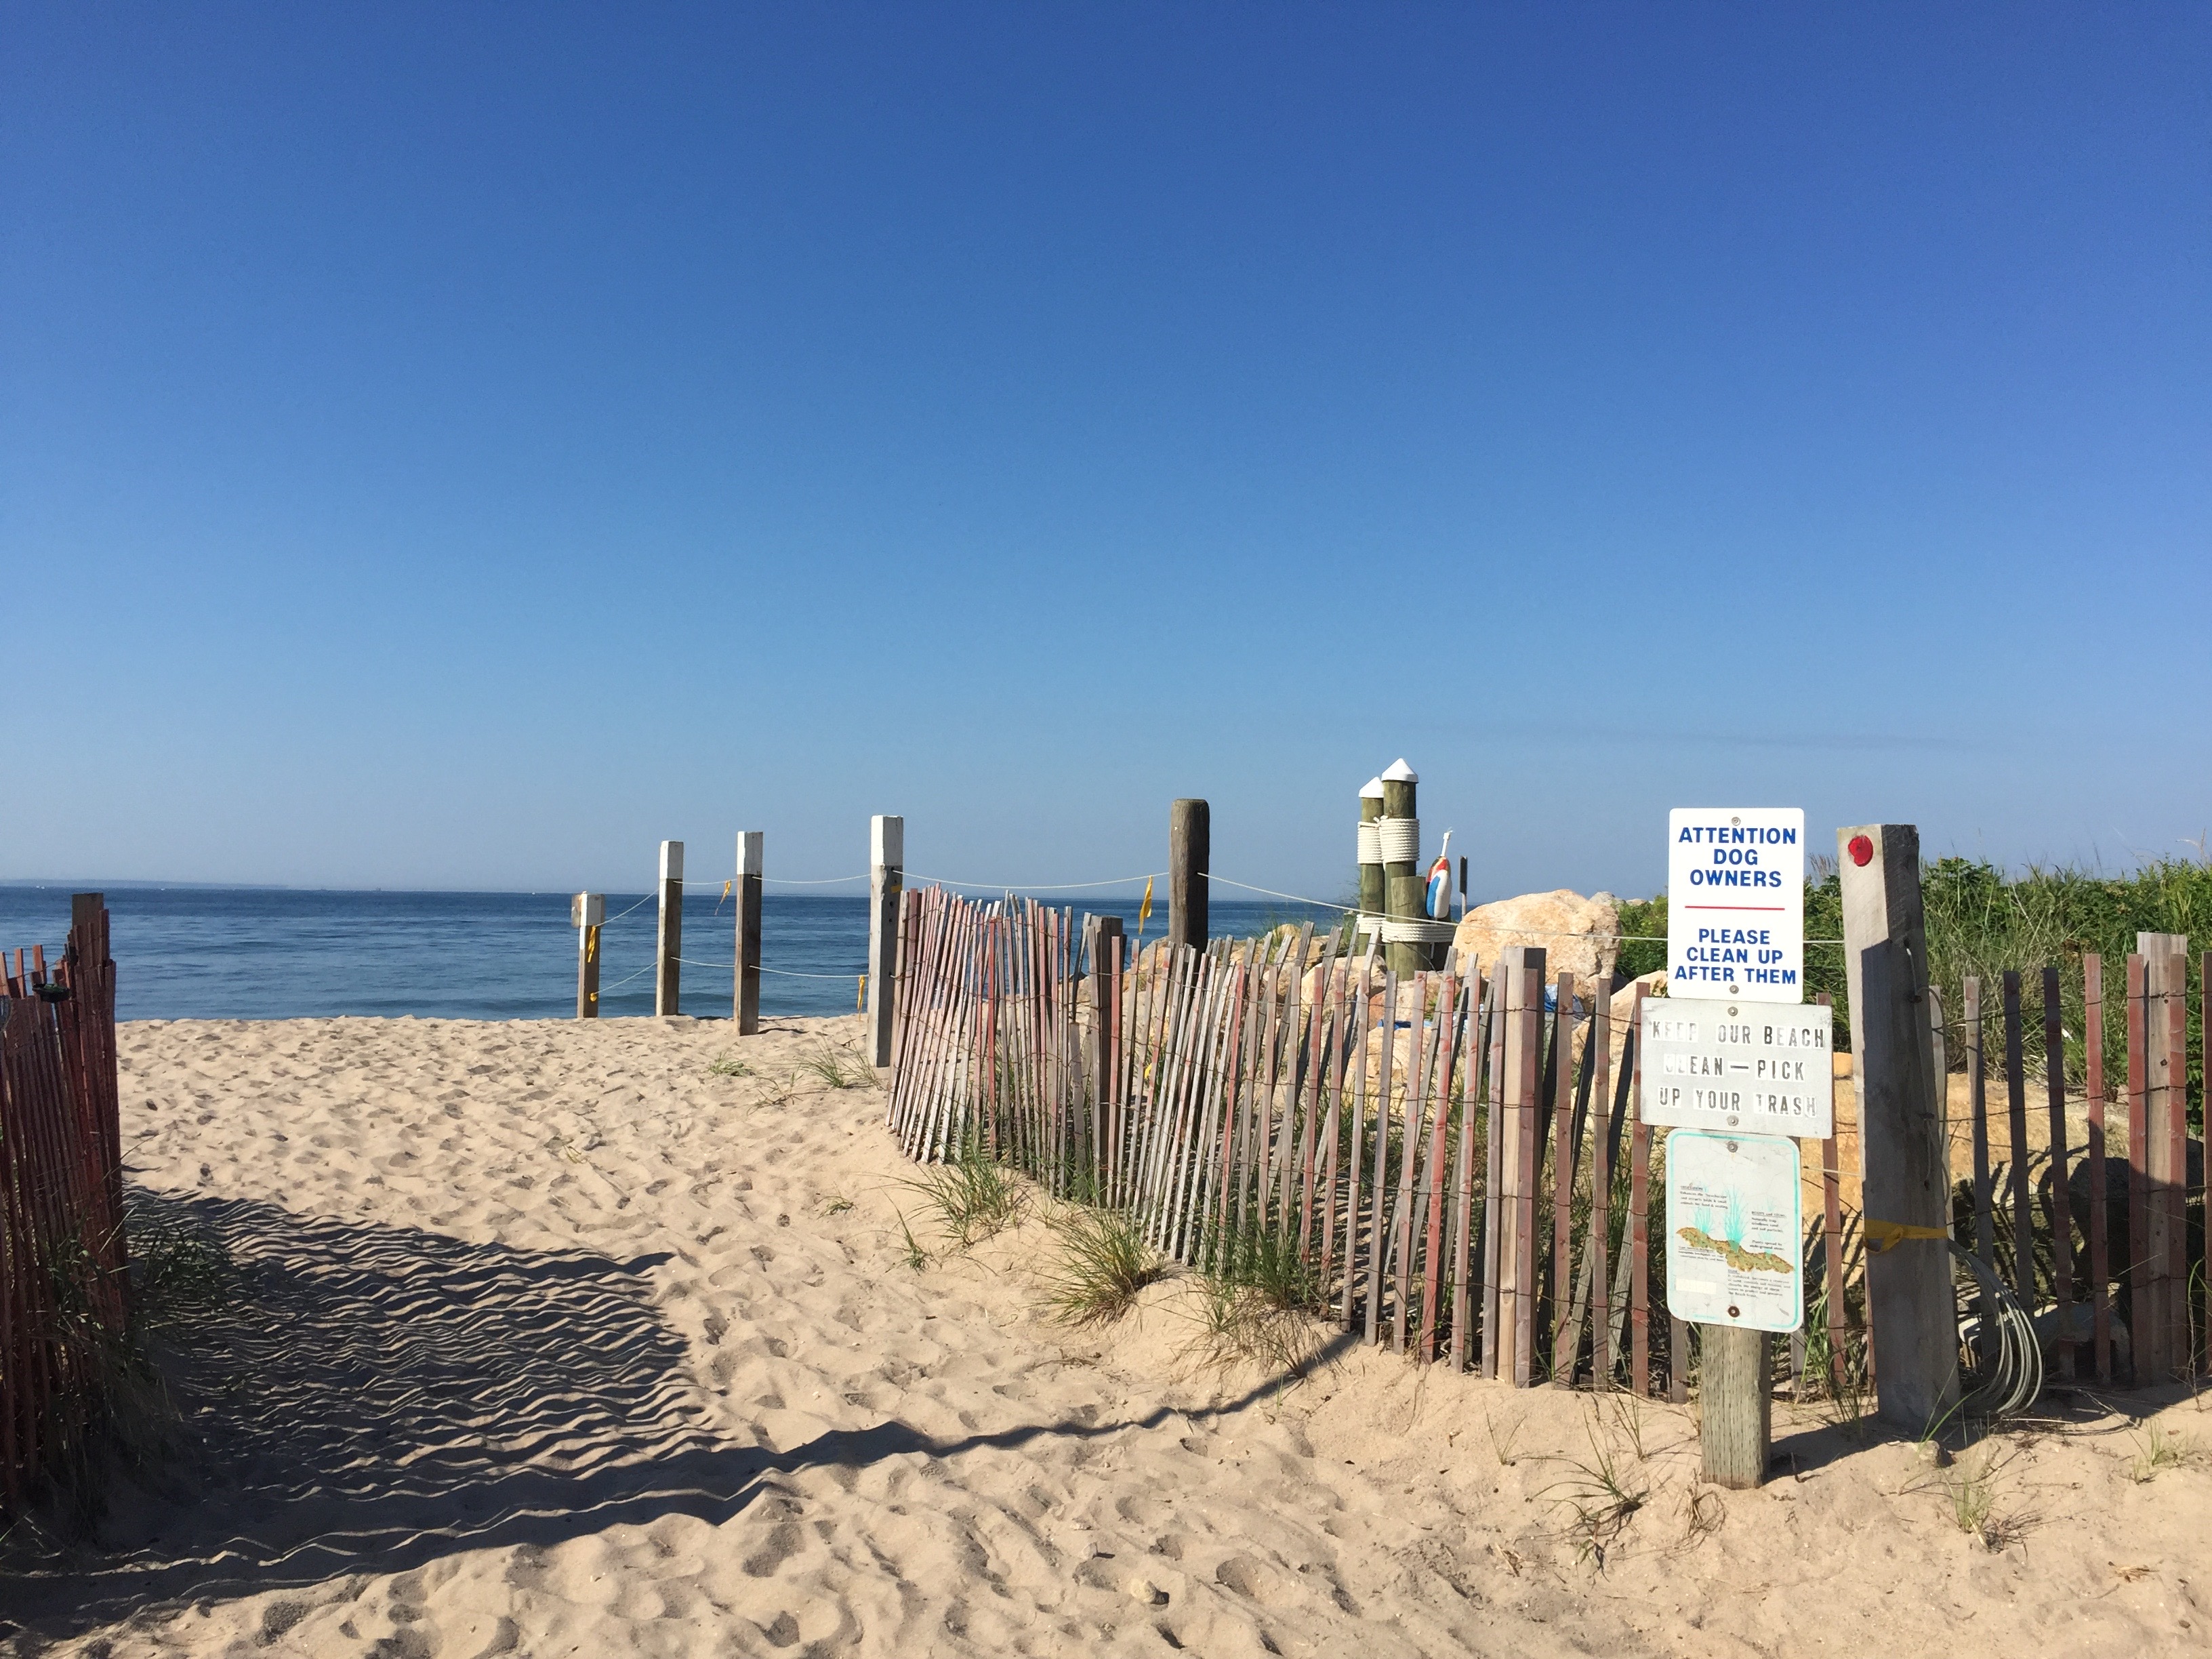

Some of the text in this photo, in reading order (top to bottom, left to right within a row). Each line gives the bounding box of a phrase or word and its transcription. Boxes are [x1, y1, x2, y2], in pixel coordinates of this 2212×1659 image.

[1679, 827, 1796, 844] ATTENTION
[1713, 848, 1758, 865] DOG
[1689, 869, 1782, 887] OWNERS
[1698, 928, 1770, 945] PLEASE
[1686, 947, 1783, 964] CLEAN UP
[1675, 966, 1796, 984] AFTER THEM
[1653, 1021, 1823, 1048] KEEP OUR BEACH
[1660, 1087, 1816, 1116] UP YOUR TRASH
